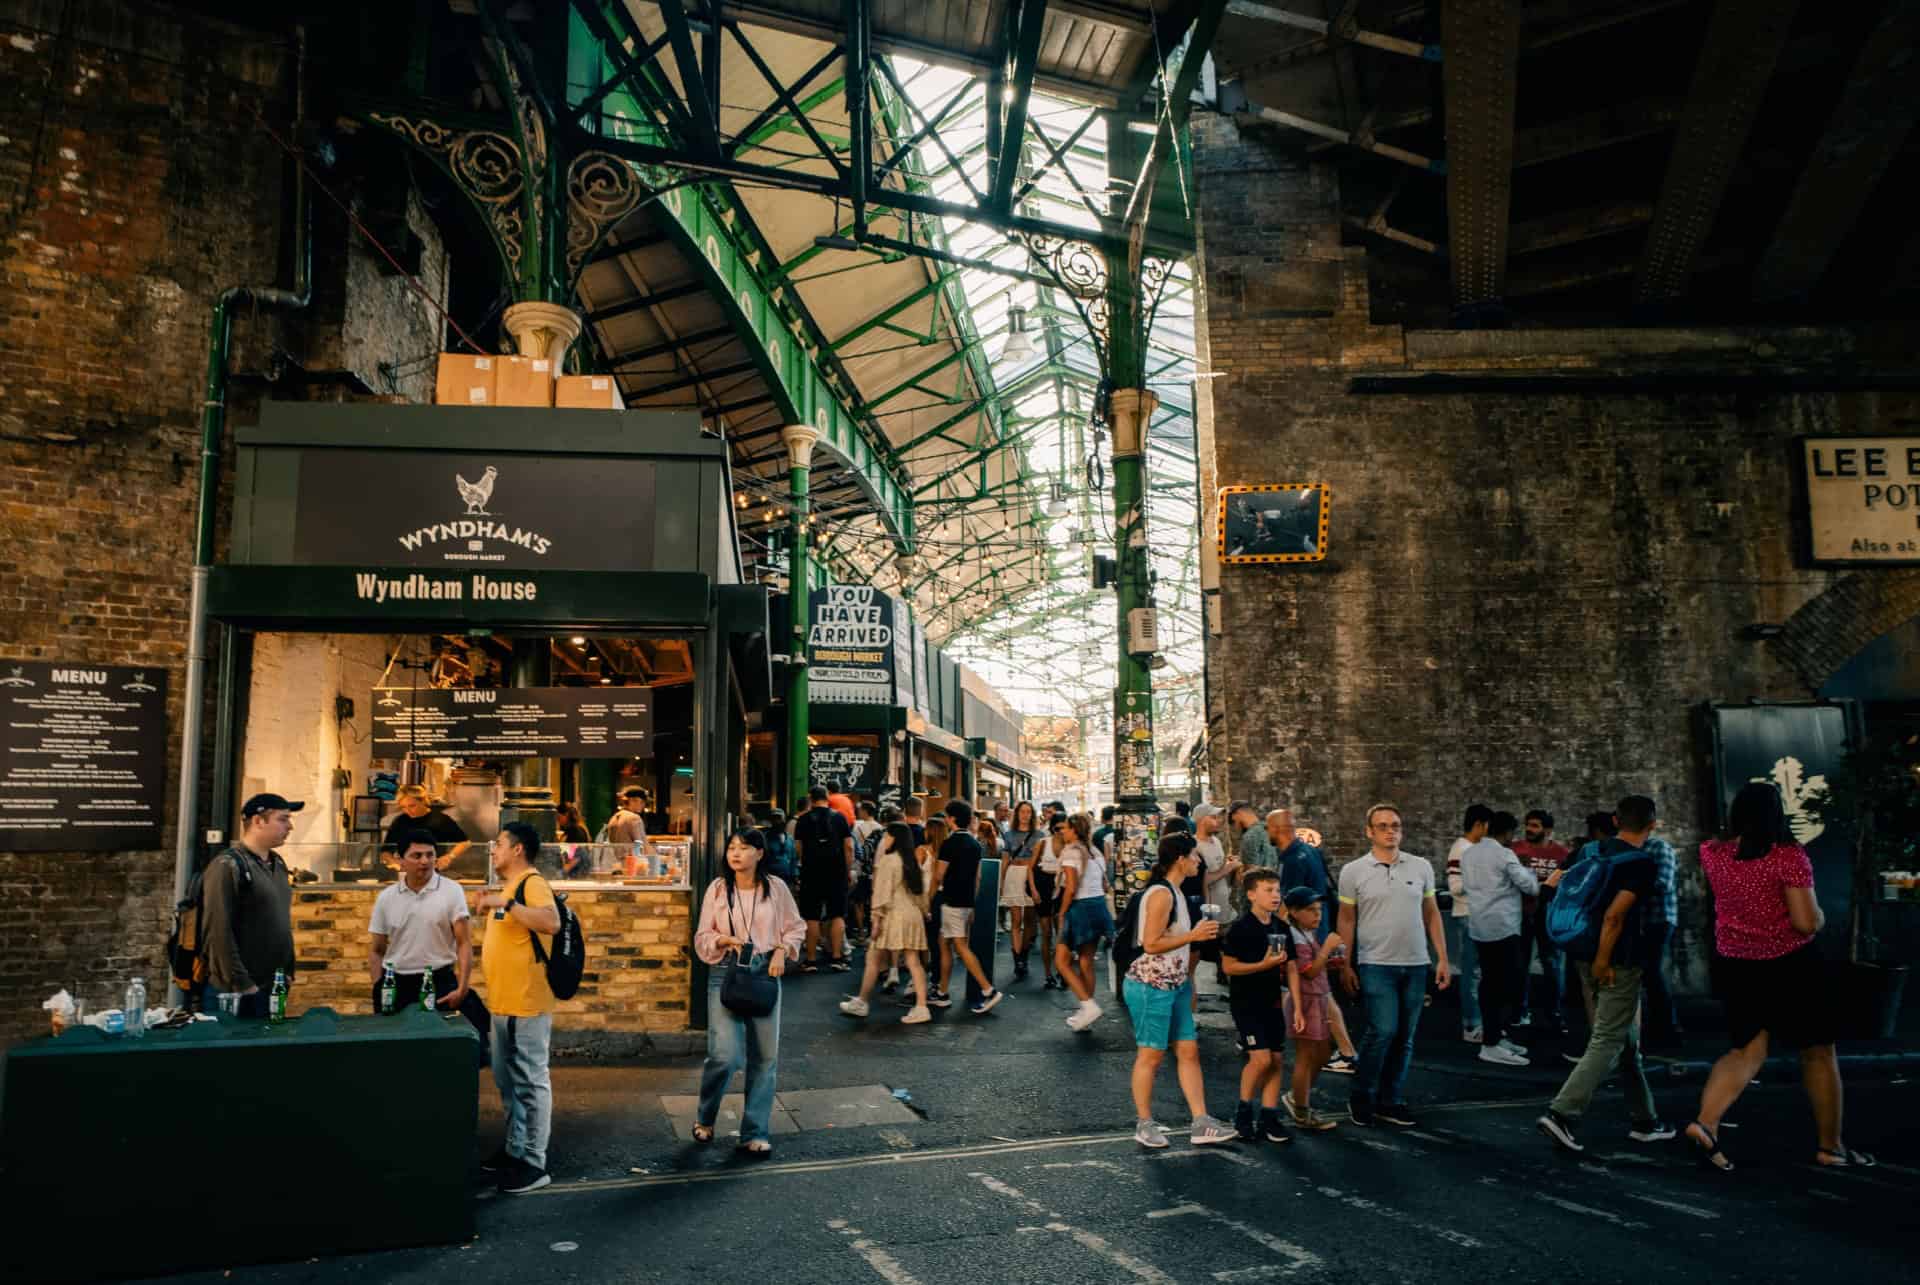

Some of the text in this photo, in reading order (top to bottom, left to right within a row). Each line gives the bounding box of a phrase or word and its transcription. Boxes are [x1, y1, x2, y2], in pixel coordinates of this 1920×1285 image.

[1812, 448, 1887, 476] LEE
[399, 520, 552, 554] WYNDHAM'S
[1851, 538, 1917, 552] Also at
[356, 574, 537, 603] Wyndham House
[830, 588, 871, 604] YOU
[821, 607, 879, 623] HAVE
[812, 627, 889, 643] ARRIVED
[51, 669, 107, 684] MENU
[453, 691, 497, 703] MENU
